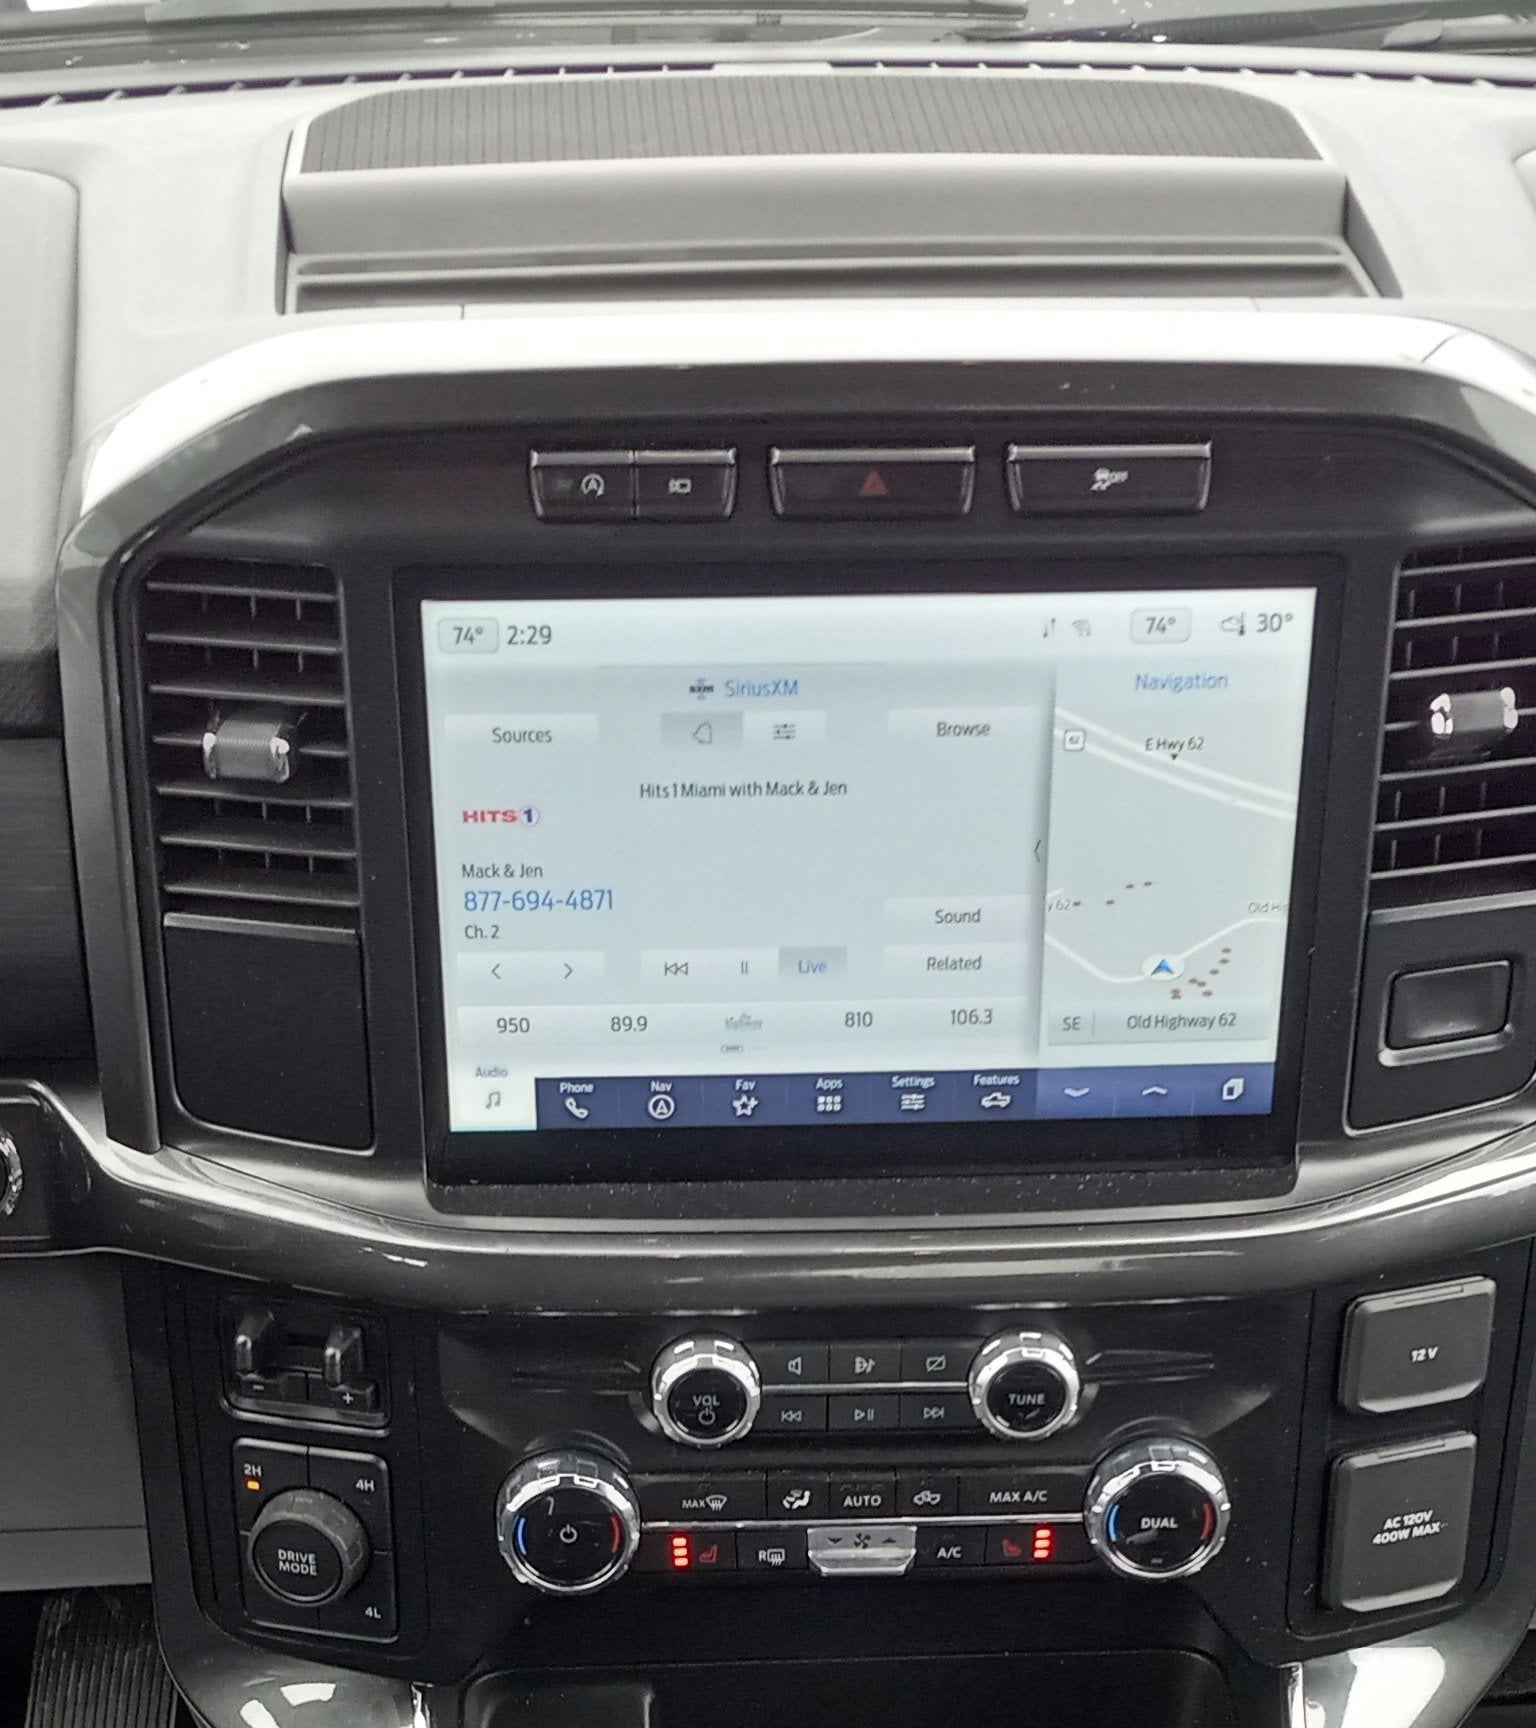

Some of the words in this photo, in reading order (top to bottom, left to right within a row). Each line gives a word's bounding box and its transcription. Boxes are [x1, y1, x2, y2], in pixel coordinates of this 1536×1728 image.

[1145, 616, 1176, 635] 74°
[1256, 612, 1295, 633] 30°
[452, 624, 485, 645] 74°
[506, 625, 553, 646] 2:29
[724, 678, 800, 698] SiriusXM
[1135, 670, 1229, 693] Navigation
[491, 726, 554, 745] Sources
[936, 720, 992, 738] Browse
[1144, 737, 1155, 752] E
[1156, 738, 1187, 755] Hwy
[1187, 735, 1206, 750] 62
[639, 782, 670, 800] Hits
[680, 780, 727, 797] Miami
[729, 777, 765, 796] with
[766, 776, 806, 795] Mack
[807, 776, 820, 795] &
[823, 774, 849, 796] Jen
[462, 809, 519, 824] HITS
[461, 862, 501, 879] Mack
[503, 862, 515, 878] &
[517, 861, 544, 879] Jen
[463, 888, 615, 913] 877-694-4871
[934, 908, 981, 924] Sound
[464, 923, 489, 940] Ch.
[490, 924, 501, 940] 2
[797, 959, 827, 975] Live
[925, 955, 983, 972] Related
[495, 1016, 532, 1035] 950
[609, 1014, 649, 1033] 89.9
[843, 1011, 874, 1029] 810
[950, 1008, 994, 1027] 106.3
[1062, 1016, 1082, 1032] SE
[1126, 1014, 1154, 1030] Old
[1154, 1012, 1216, 1034] Highway
[1217, 1012, 1237, 1028] 62
[474, 1066, 509, 1080] Audio
[891, 1072, 936, 1089] Settings
[973, 1072, 1020, 1087] Features
[559, 1080, 595, 1096] Phone
[651, 1080, 673, 1094] Nav
[735, 1079, 756, 1093] Fav
[815, 1076, 844, 1093] Apps
[692, 1394, 720, 1408] VOL
[1008, 1393, 1045, 1406] TUNE
[244, 1464, 262, 1477] 2H
[356, 1478, 375, 1492] 4H
[681, 1500, 706, 1509] MAX
[843, 1495, 882, 1508] AUTO
[989, 1491, 1020, 1504] MAX
[1023, 1490, 1048, 1503] A/C
[1140, 1517, 1178, 1530] DUAL
[1384, 1517, 1402, 1530] AC
[1402, 1509, 1433, 1526] 120V
[1372, 1530, 1409, 1546] 400W
[1411, 1521, 1441, 1538] MAX
[278, 1549, 316, 1565] DRIVE
[937, 1546, 962, 1559] A/C
[278, 1560, 317, 1576] MODE
[365, 1606, 382, 1619] 4L
